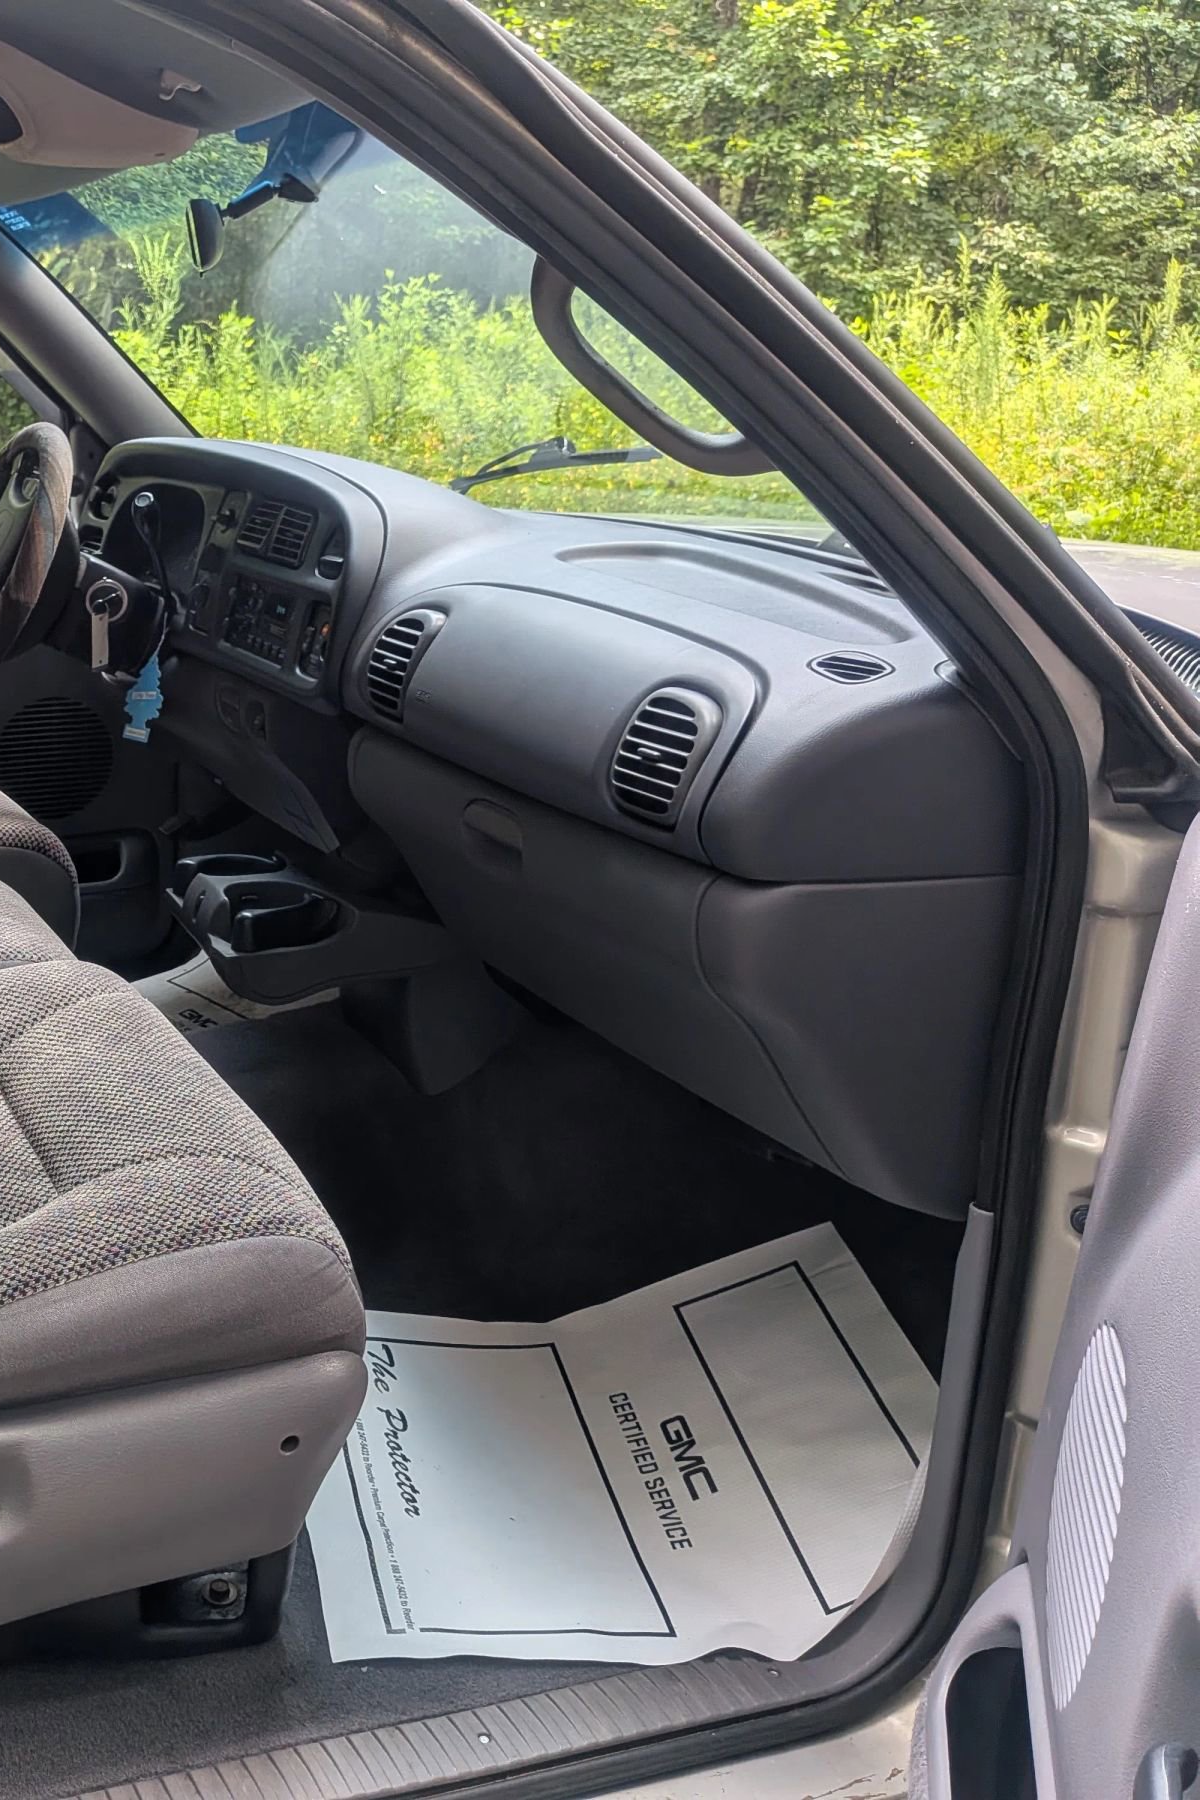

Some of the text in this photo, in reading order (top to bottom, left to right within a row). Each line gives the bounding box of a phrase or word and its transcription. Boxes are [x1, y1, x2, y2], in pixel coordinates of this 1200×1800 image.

[178, 1009, 218, 1028] GMC
[367, 1344, 420, 1518] The Protector
[609, 1392, 693, 1550] CERTIFIED SERVICE
[660, 1415, 719, 1501] GMC
[364, 1463, 375, 1484] Reorder
[370, 1488, 382, 1510] Premium
[376, 1512, 387, 1527] Carpet
[402, 1608, 415, 1630] Reorder
